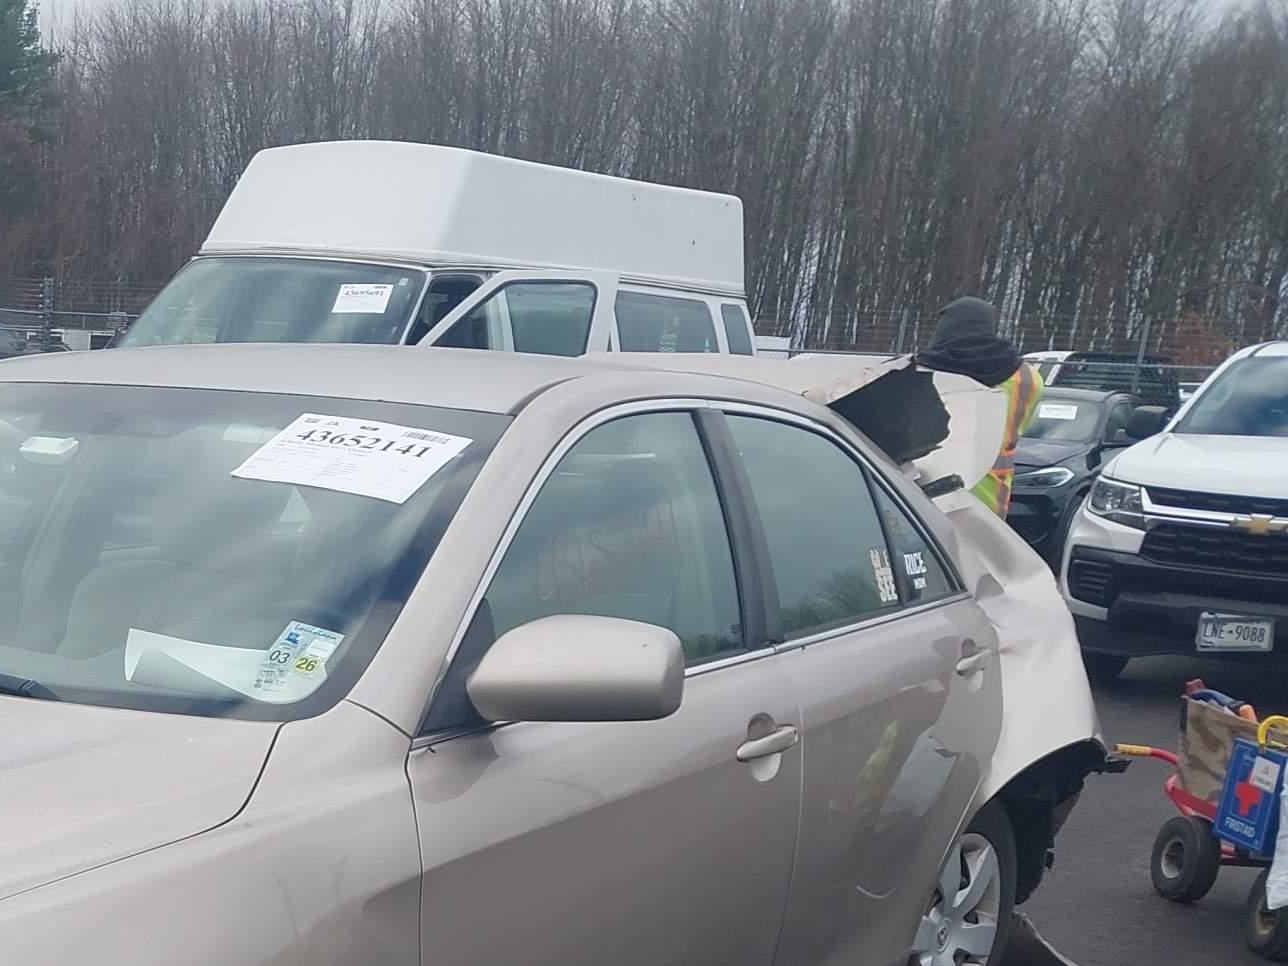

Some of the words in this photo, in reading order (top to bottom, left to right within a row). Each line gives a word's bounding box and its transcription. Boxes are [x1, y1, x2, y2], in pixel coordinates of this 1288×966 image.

[297, 429, 432, 459] 43652141
[269, 650, 290, 664] 03
[296, 657, 317, 672] 26
